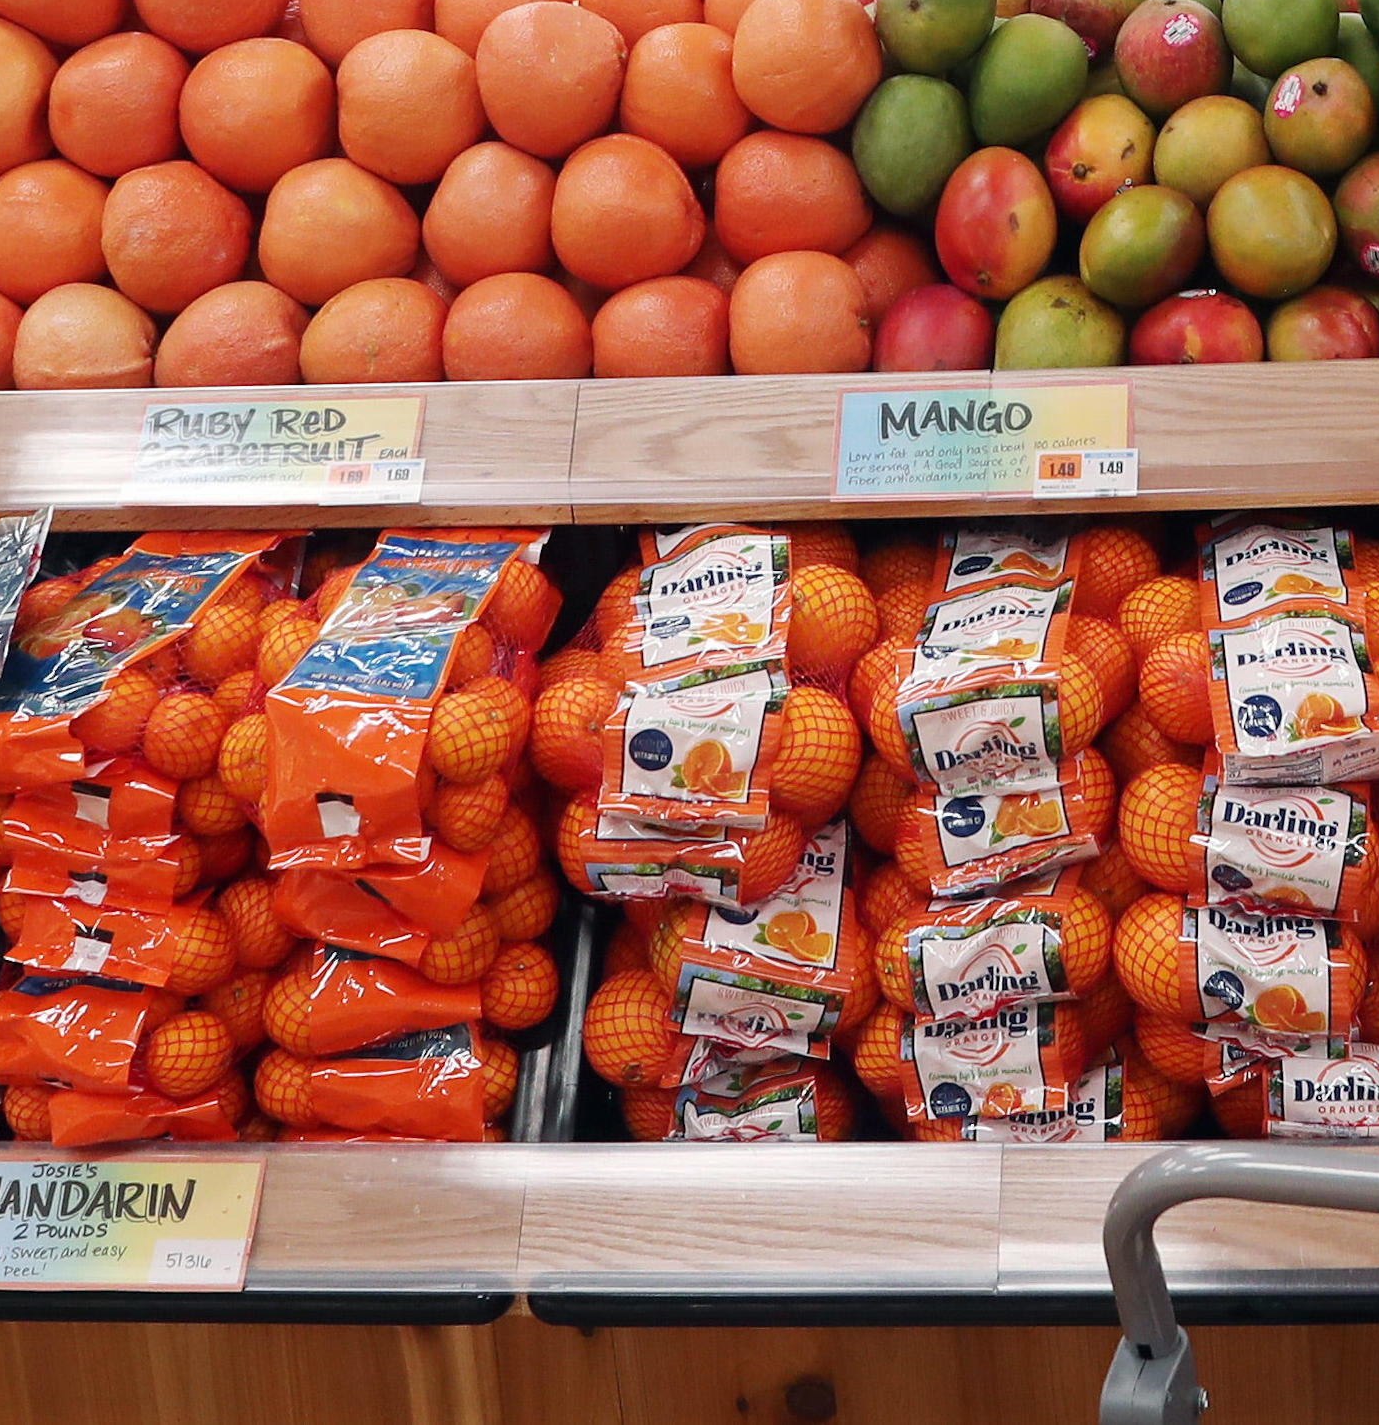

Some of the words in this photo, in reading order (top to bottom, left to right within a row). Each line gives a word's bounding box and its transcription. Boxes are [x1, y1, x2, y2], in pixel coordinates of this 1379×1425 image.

[878, 397, 1033, 441] MANGO
[378, 447, 408, 459] EACH
[889, 448, 907, 460] fat
[913, 446, 935, 459] and
[937, 444, 963, 462] only
[966, 443, 988, 456] has
[992, 440, 1025, 455] about
[1052, 435, 1096, 449] calories
[1224, 540, 1330, 568] Darling
[660, 560, 763, 597] Darling
[1222, 800, 1339, 851] Darling
[935, 966, 1042, 1002] Darling
[32, 1162, 99, 1179] JOSIE'S
[12, 1224, 29, 1241] 2
[35, 1223, 110, 1240] POUNDS
[61, 1242, 89, 1260] and
[92, 1242, 128, 1262] easy
